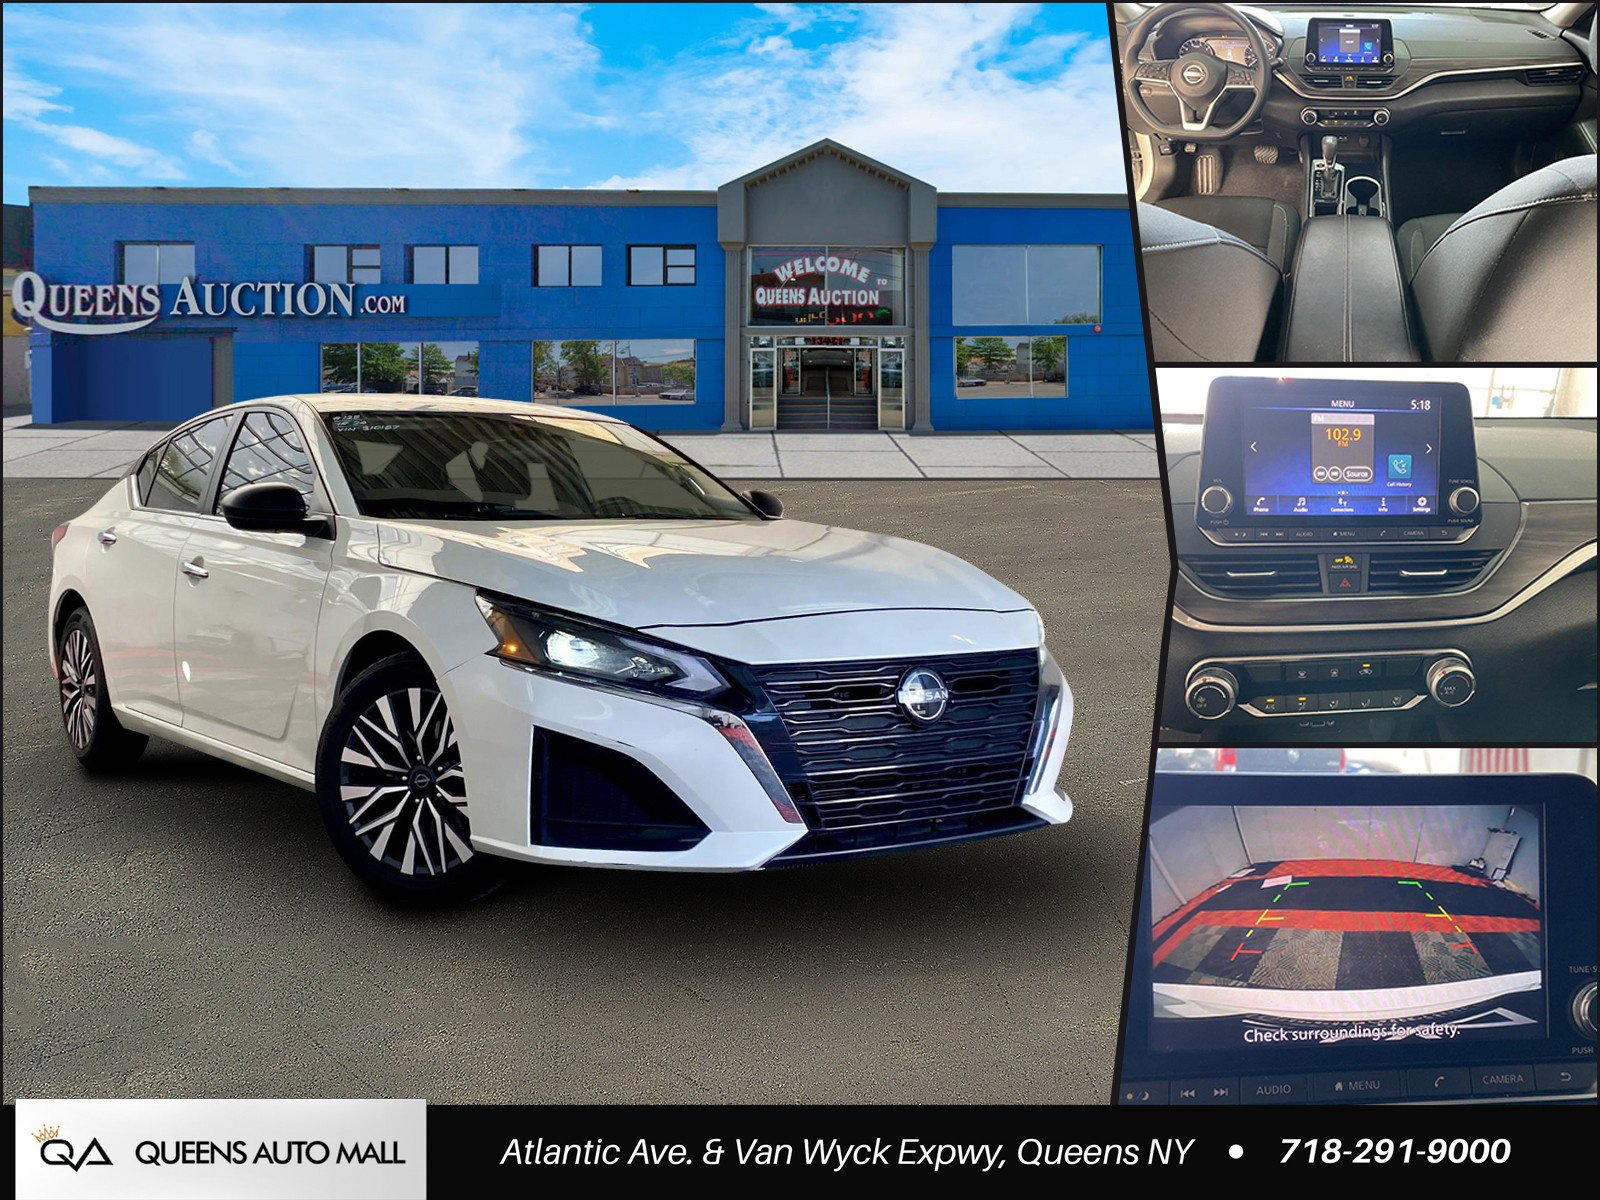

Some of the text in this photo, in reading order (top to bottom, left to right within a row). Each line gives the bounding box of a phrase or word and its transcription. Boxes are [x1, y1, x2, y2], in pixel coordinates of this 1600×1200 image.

[774, 256, 871, 284] WELCOME
[755, 287, 879, 306] QUEENS AUCTION
[12, 271, 161, 334] QUEENS
[170, 276, 355, 317] AUCTION
[1331, 400, 1355, 408] MENU
[1411, 399, 1431, 410] 5:18
[1325, 428, 1362, 441] 102.9
[1346, 470, 1368, 478] Source
[1244, 1022, 1460, 1042] Check surroundings for safety.
[1571, 1046, 1594, 1054] PUSH
[1482, 1074, 1524, 1085] CAMERA
[1255, 1084, 1292, 1096] AUDIO
[1348, 1080, 1381, 1091] MENU
